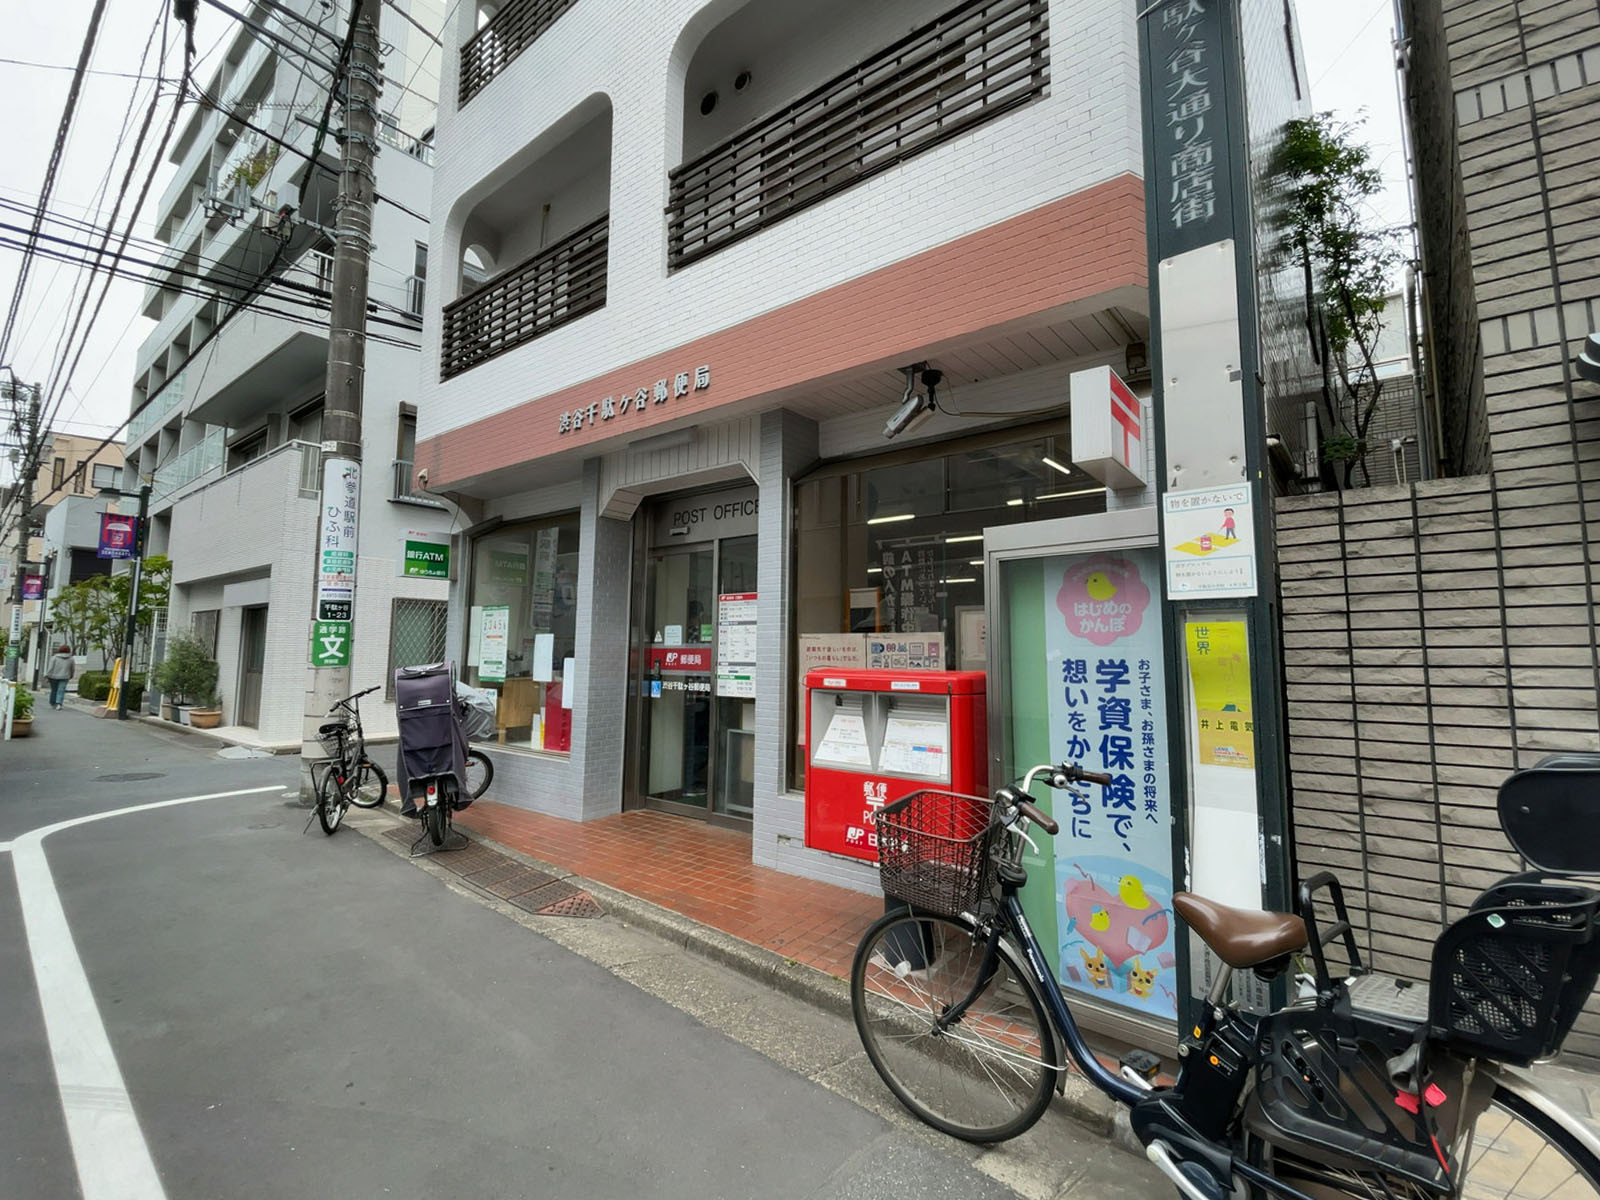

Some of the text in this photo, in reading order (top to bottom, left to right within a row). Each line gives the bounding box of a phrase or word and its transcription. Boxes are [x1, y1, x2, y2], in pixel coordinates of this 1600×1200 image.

[1170, 493, 1244, 510] 物を置かないで
[673, 507, 707, 526] POST
[1074, 600, 1132, 617] はじめの
[1080, 616, 1127, 634] かんぽ
[319, 635, 344, 659] 文
[1195, 626, 1210, 655] 世界
[1138, 659, 1159, 824] お子さま、お孫さまの将来へ
[1095, 658, 1137, 852] 学資保険で、
[863, 781, 887, 799] 郵便
